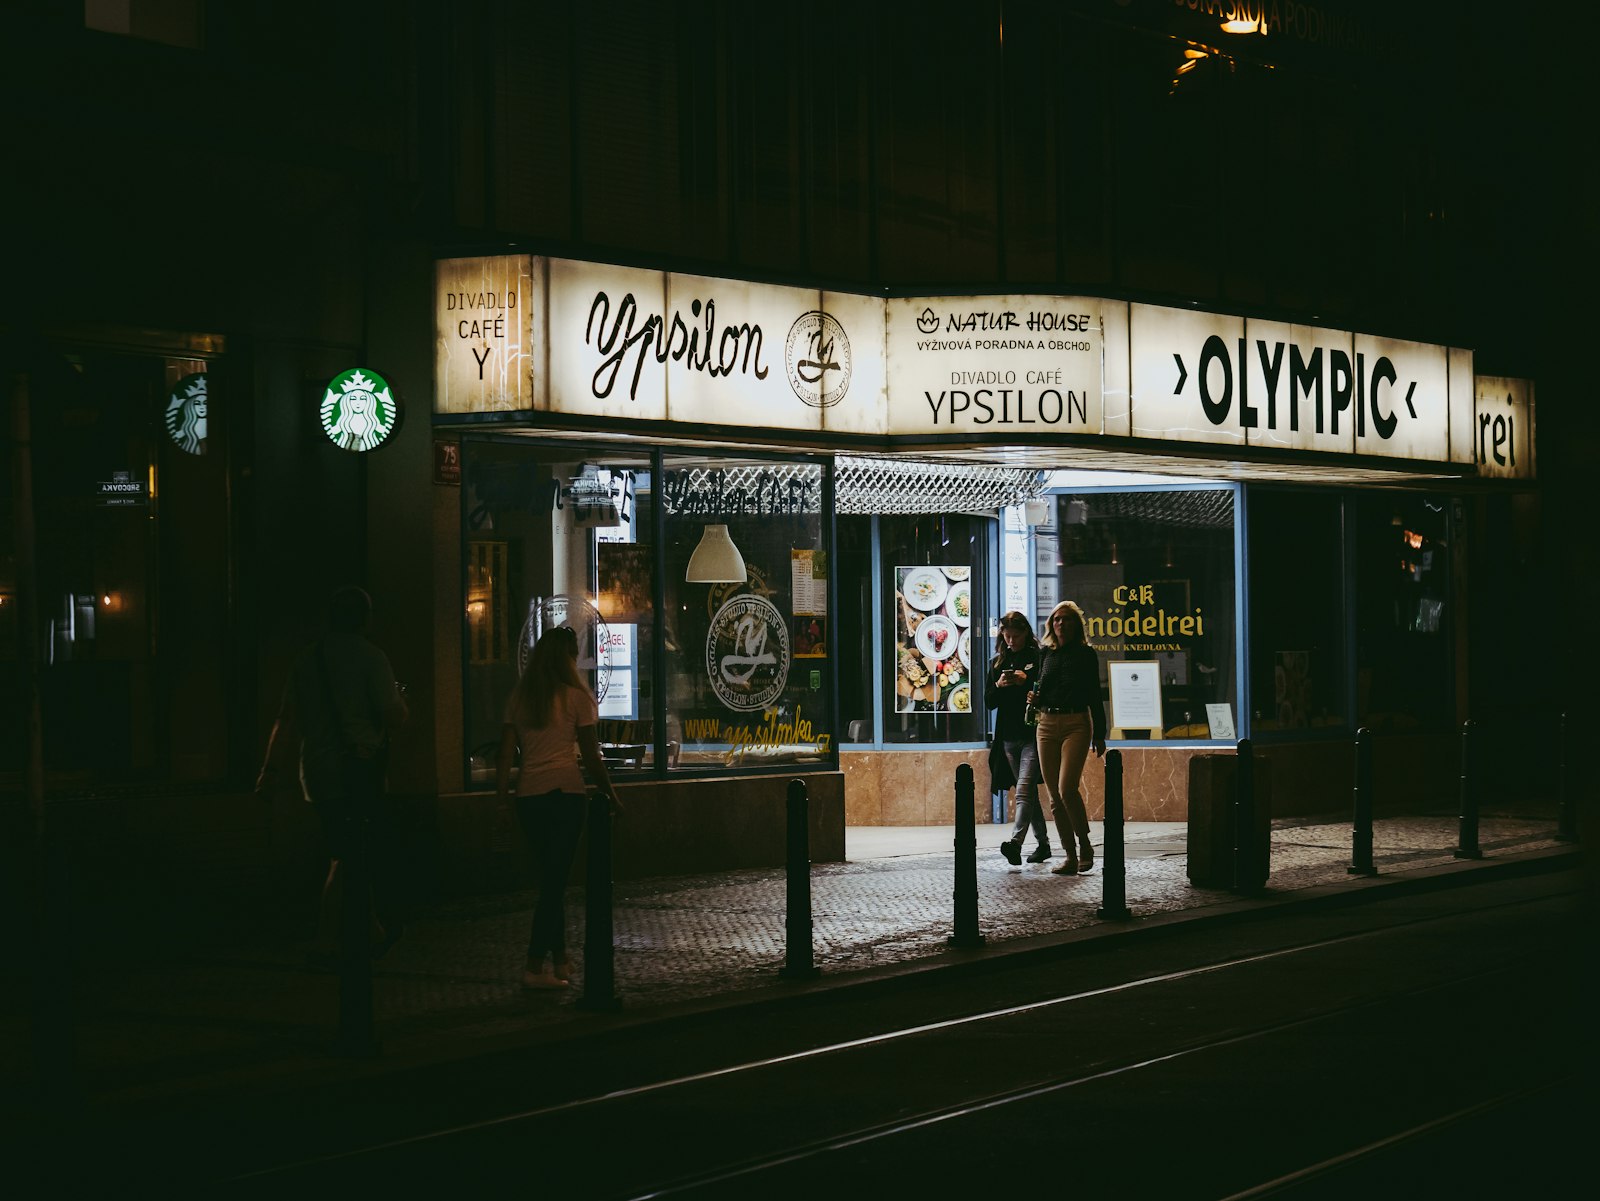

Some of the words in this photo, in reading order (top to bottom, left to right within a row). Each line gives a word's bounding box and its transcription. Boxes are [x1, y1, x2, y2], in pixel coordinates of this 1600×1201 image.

[447, 292, 516, 311] DIVADLO
[458, 314, 505, 339] CAFÉ
[946, 311, 1020, 333] NATUR
[1026, 311, 1091, 332] HOUSE
[917, 338, 972, 351] VÝŽIVOVÁ
[975, 339, 1034, 350] PORADNA
[1037, 340, 1045, 350] A
[1048, 340, 1090, 351] OBCHOD
[472, 347, 491, 380] Y
[951, 370, 1016, 385] DIVADLO
[1026, 367, 1063, 385] CAFÉ
[1198, 334, 1398, 440] OLYMPIC
[924, 389, 1087, 425] YPSILON
[1479, 392, 1515, 467] rei
[1087, 608, 1204, 638] nödelrei
[1123, 643, 1182, 651] KNEDLOVNA
